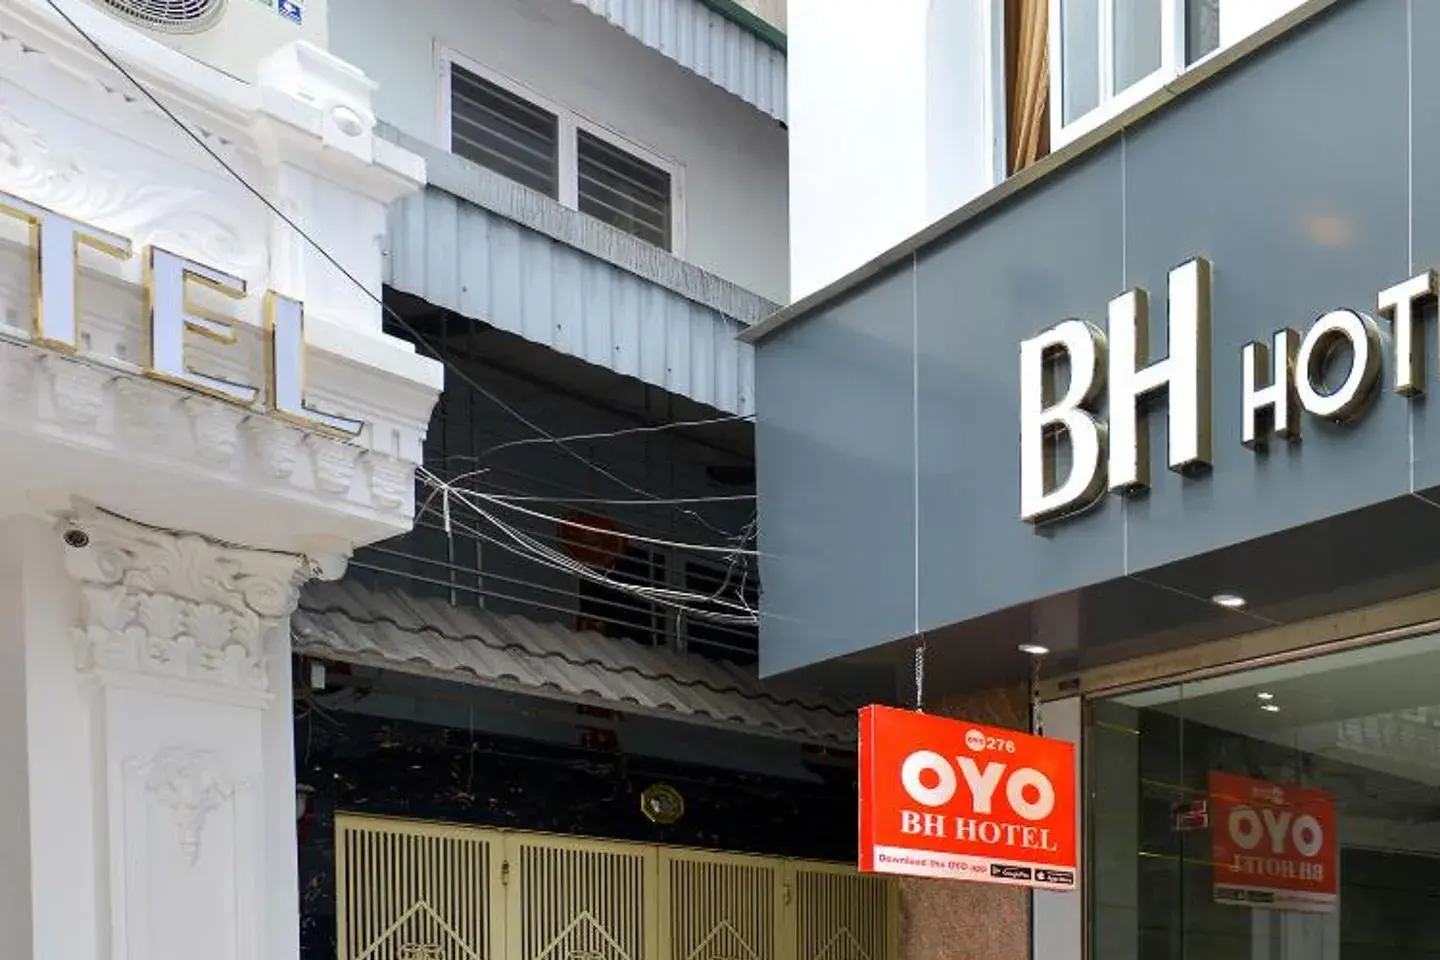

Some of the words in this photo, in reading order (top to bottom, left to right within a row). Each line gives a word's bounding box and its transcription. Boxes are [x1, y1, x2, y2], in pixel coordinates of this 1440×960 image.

[1020, 255, 1214, 526] BH
[986, 737, 1016, 753] 276
[901, 750, 1056, 821] OYO
[901, 810, 947, 838] BH
[956, 817, 1058, 852] HOTEL
